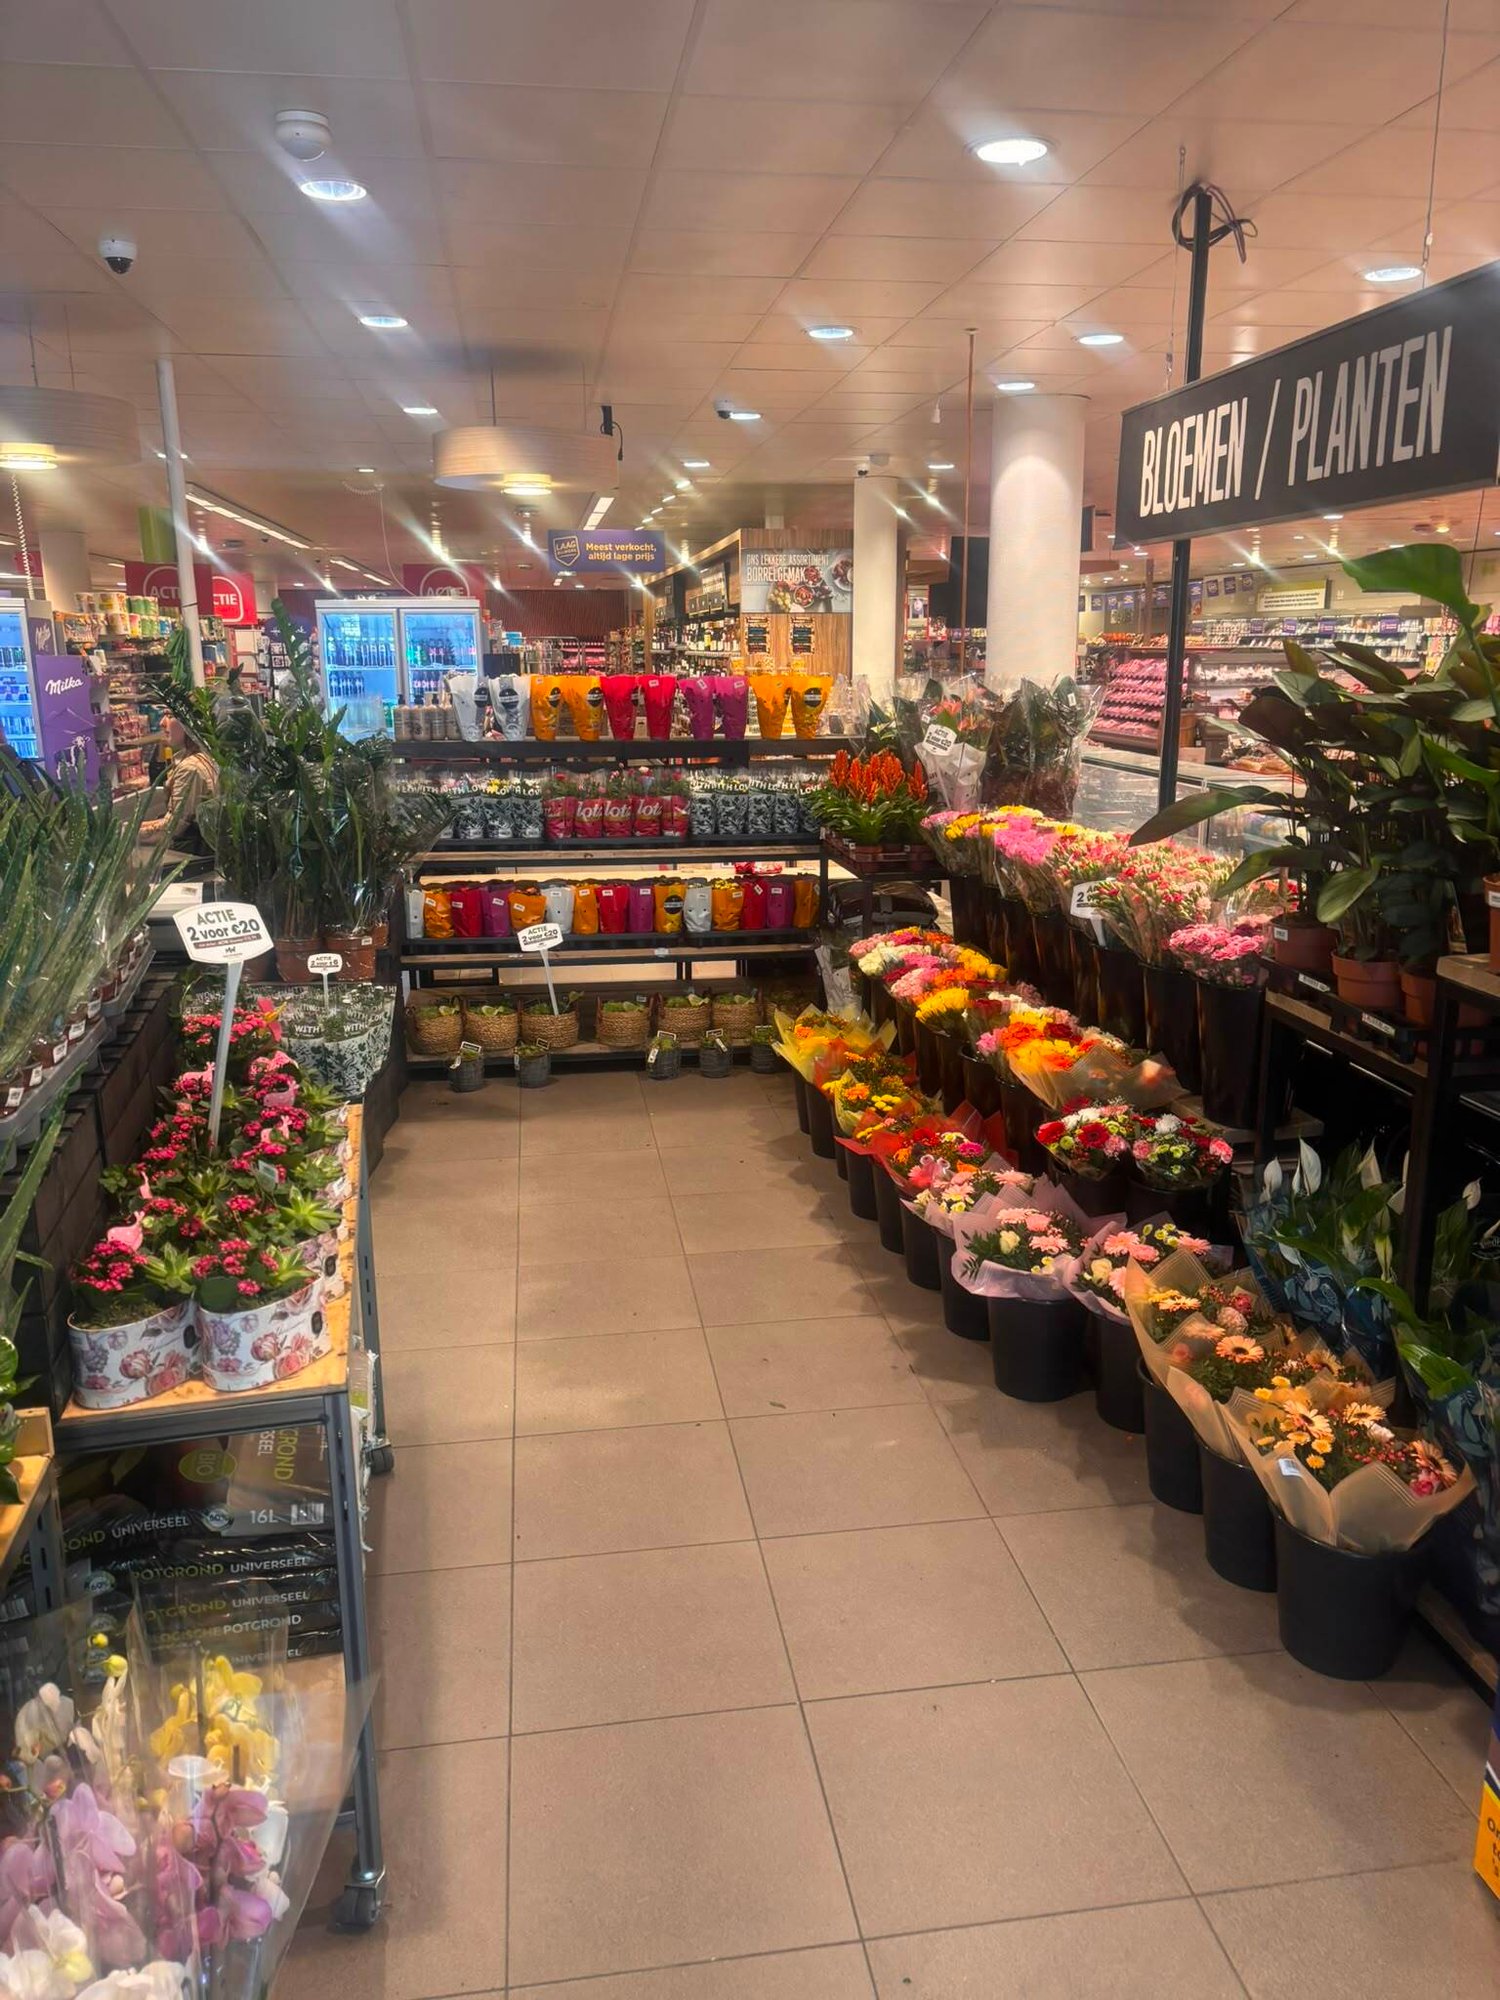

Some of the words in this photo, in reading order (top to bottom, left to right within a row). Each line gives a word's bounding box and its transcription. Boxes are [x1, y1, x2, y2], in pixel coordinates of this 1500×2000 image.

[1140, 397, 1248, 517] BLOEMEN
[1255, 378, 1281, 500] /
[1288, 326, 1453, 486] PLANTEN
[586, 543, 613, 551] Meest
[615, 543, 657, 552] verkocht,
[588, 552, 612, 561] altijd
[613, 552, 633, 561] lage
[635, 552, 655, 562] prijs
[746, 566, 808, 582] BORRELGEMAK
[150, 586, 181, 600] ACT
[45, 676, 84, 695] Milka
[1076, 891, 1085, 903] 2
[196, 909, 237, 926] ACTIE
[187, 926, 200, 941] 2
[200, 926, 229, 940] voor
[231, 918, 260, 935] €20
[528, 925, 547, 935] ACTIE
[294, 1024, 320, 1034] WITH
[196, 1452, 217, 1476] BIO
[250, 1508, 279, 1524] 16L
[111, 1515, 190, 1539] UNIVERSEEL
[230, 1556, 309, 1574] UNIVERSEEL
[231, 1591, 310, 1609] UNIVERSEEL
[223, 1614, 302, 1635] POTGROND
